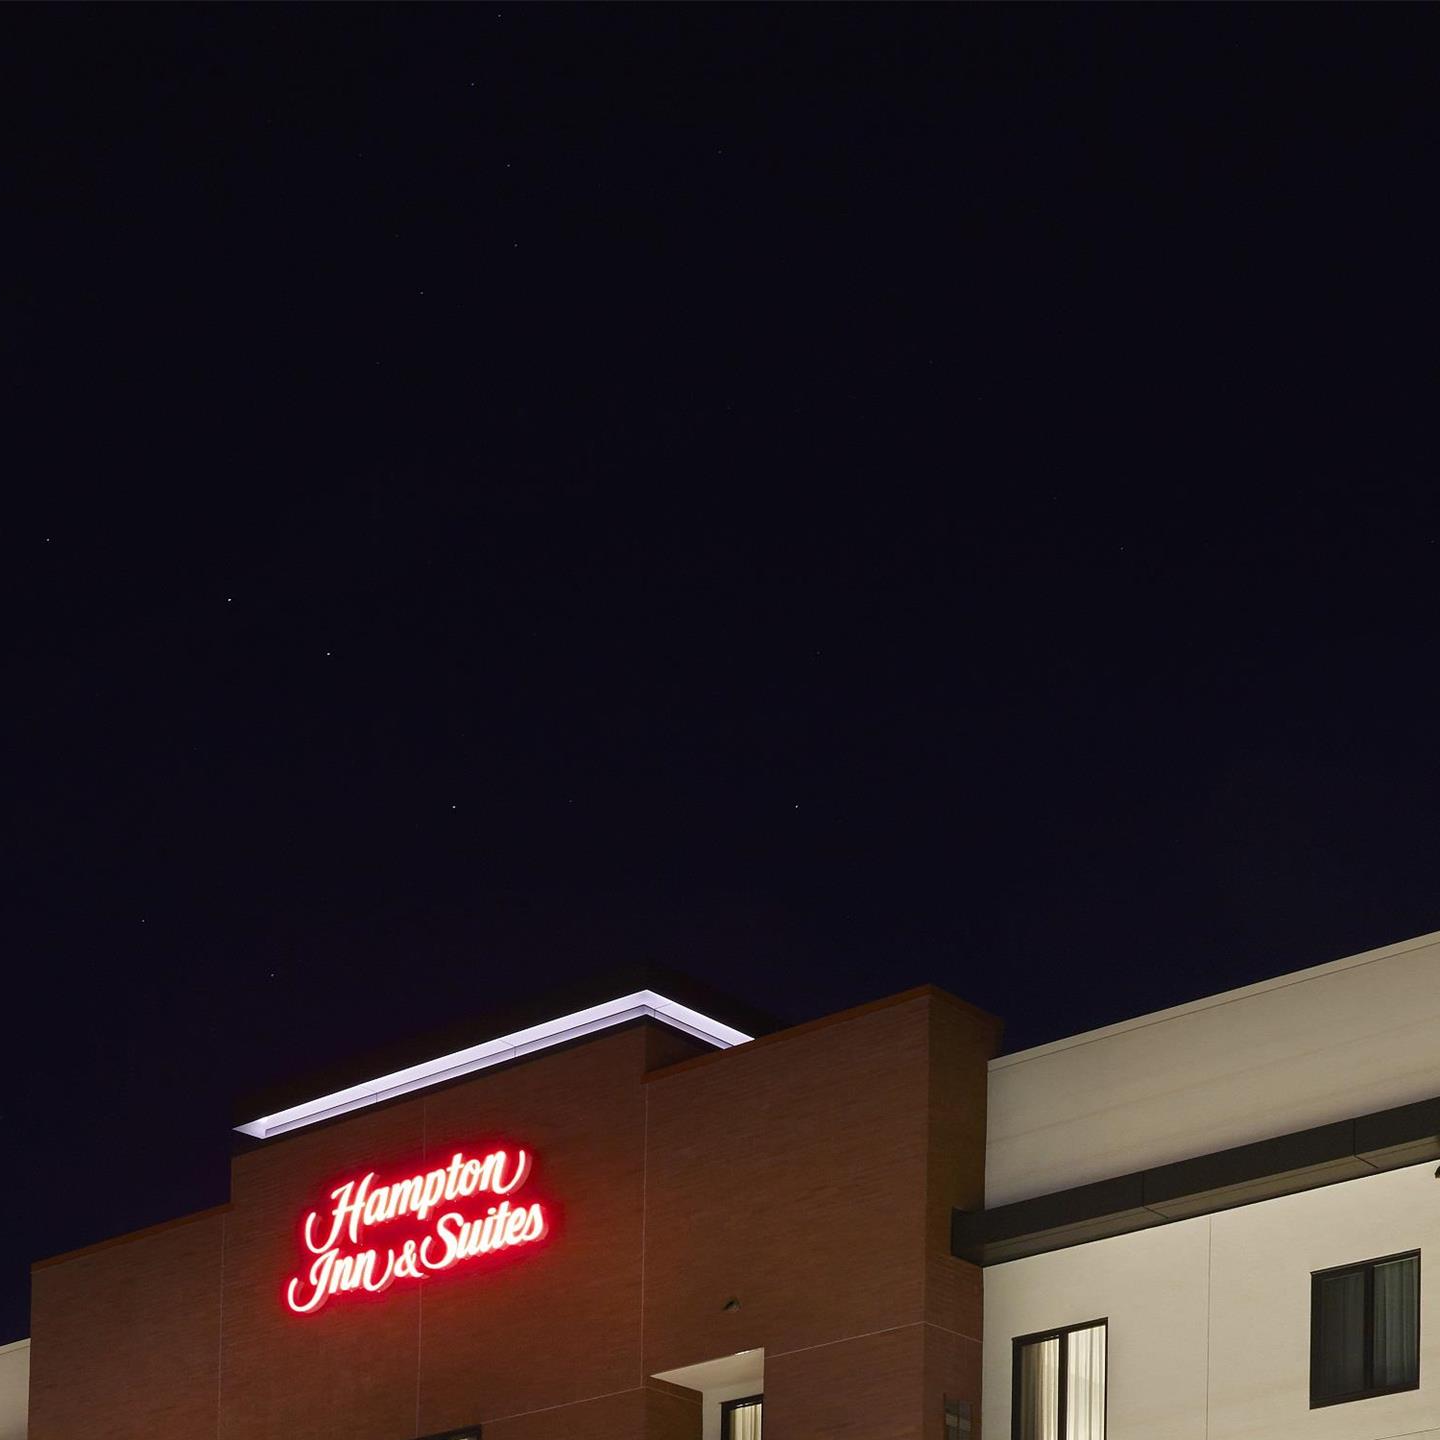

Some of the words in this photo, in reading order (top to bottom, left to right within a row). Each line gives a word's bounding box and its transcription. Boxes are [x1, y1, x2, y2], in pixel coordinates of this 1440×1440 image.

[287, 1248, 394, 1312] Inn
[393, 1239, 428, 1278] &
[419, 1200, 548, 1270] Suites
[304, 1150, 530, 1254] Hampton
